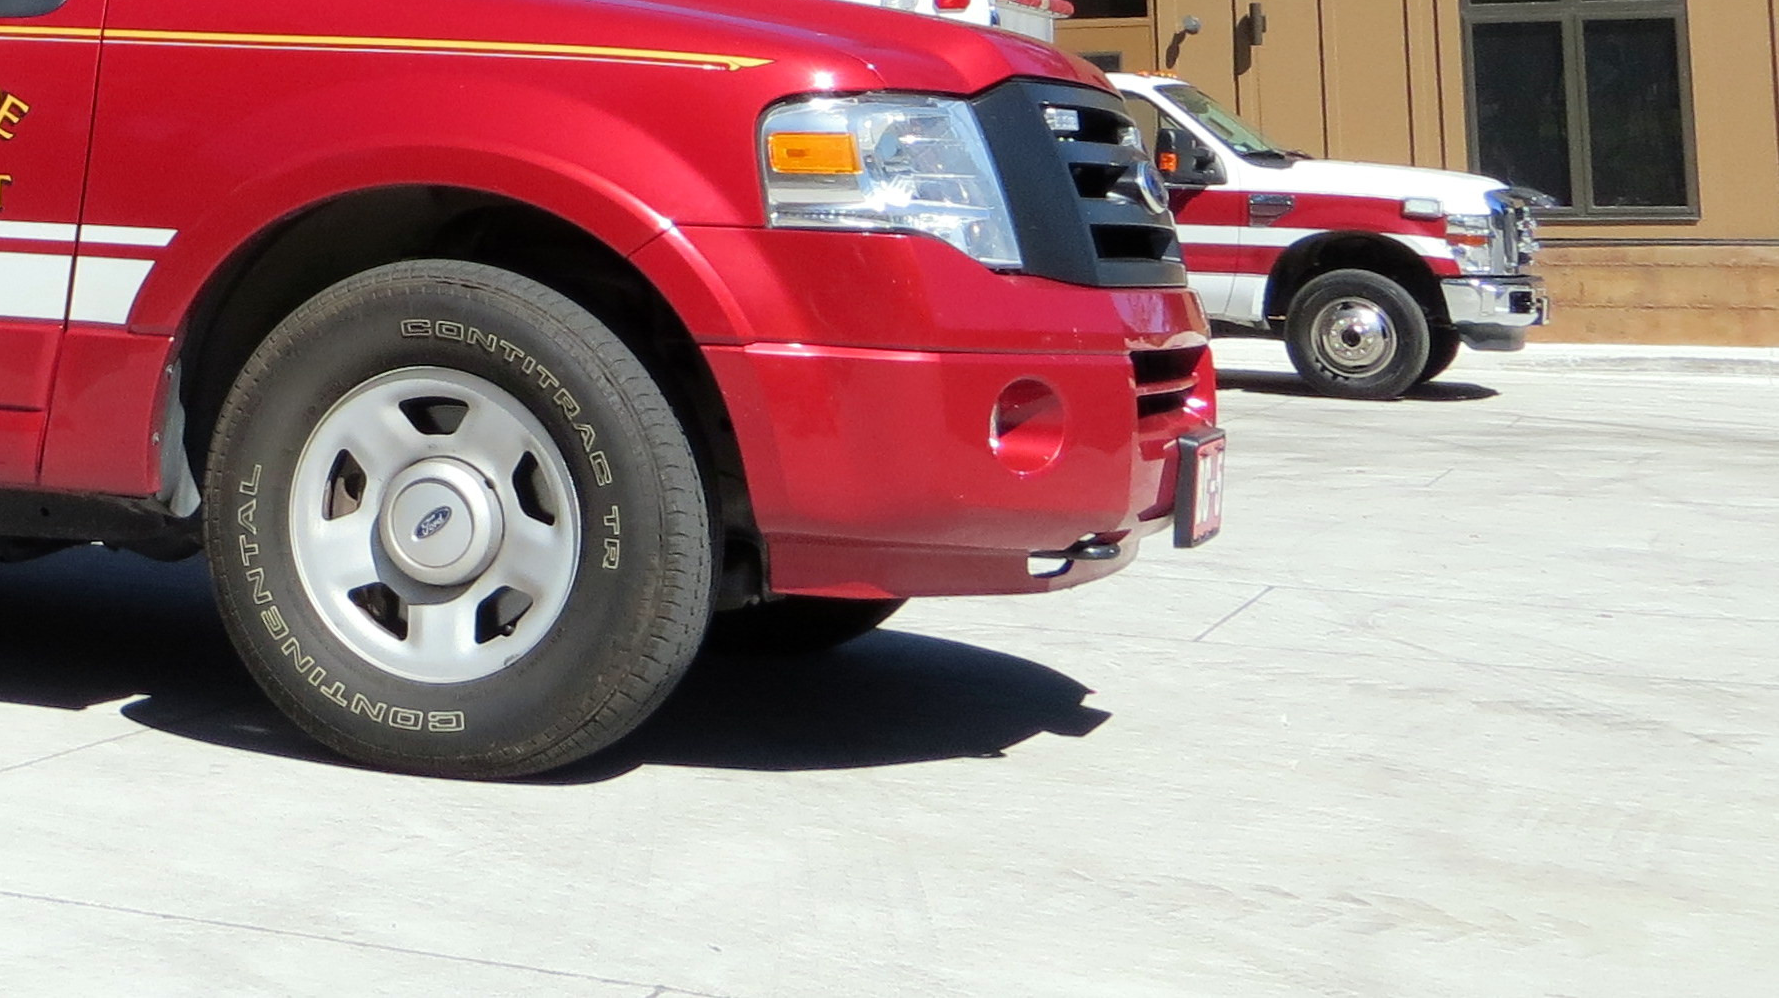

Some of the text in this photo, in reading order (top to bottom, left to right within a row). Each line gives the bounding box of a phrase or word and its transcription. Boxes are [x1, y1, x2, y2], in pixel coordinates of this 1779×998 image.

[400, 319, 621, 571] CONTITRAC TR
[418, 510, 448, 537] Ford
[238, 463, 466, 733] CONTINENTAL
